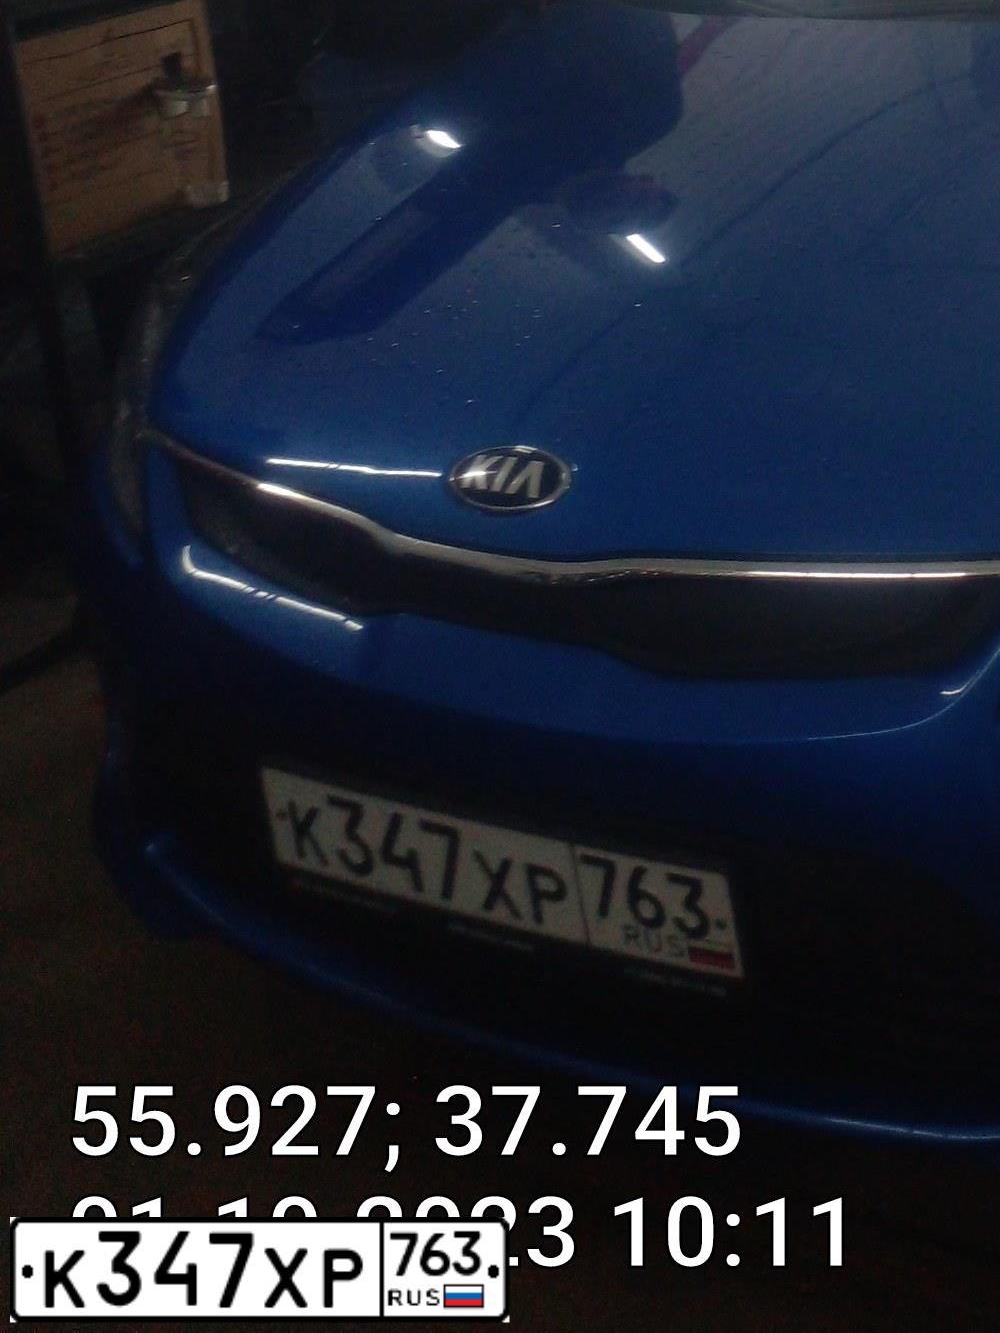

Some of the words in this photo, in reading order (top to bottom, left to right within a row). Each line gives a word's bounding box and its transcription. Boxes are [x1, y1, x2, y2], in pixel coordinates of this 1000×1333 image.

[460, 454, 545, 499] KIA
[579, 854, 710, 939] 763
[623, 924, 690, 960] RUS
